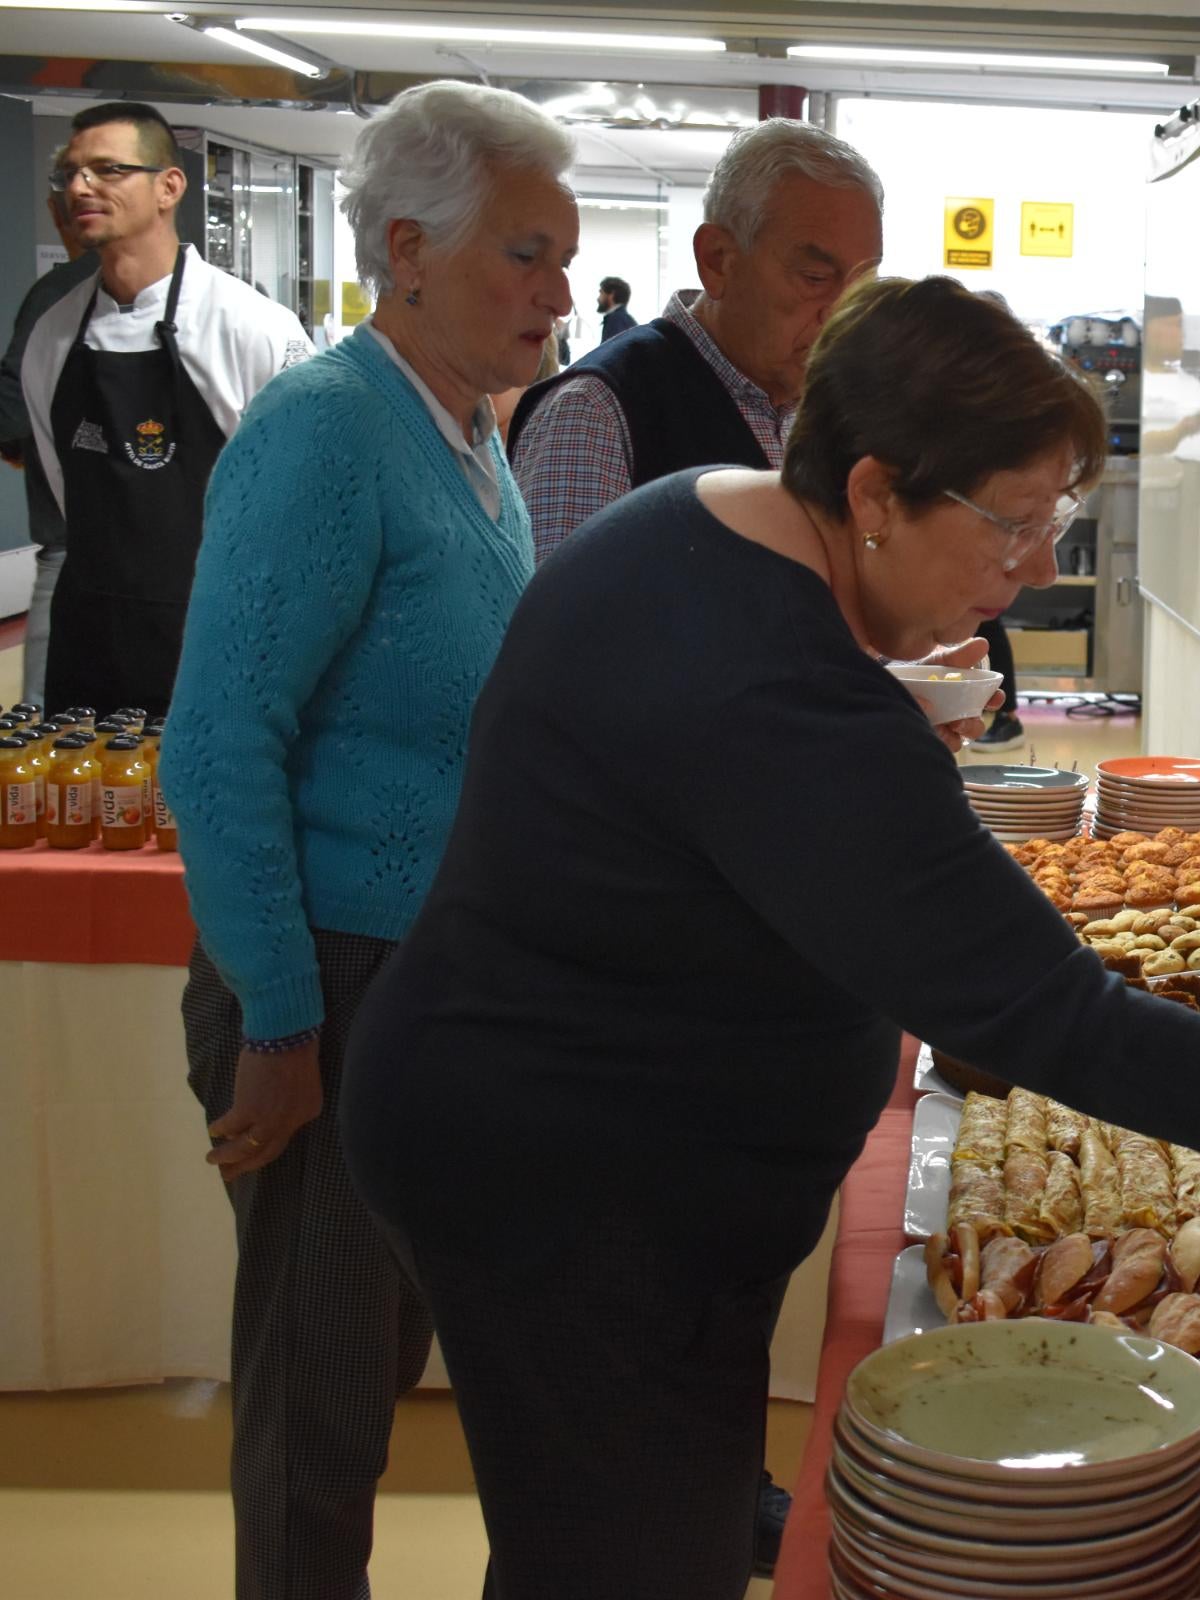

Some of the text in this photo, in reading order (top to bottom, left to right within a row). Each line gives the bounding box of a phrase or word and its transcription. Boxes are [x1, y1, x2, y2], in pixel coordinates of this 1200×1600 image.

[9, 785, 19, 806] vida
[68, 786, 78, 807] vida
[104, 790, 115, 825] vida
